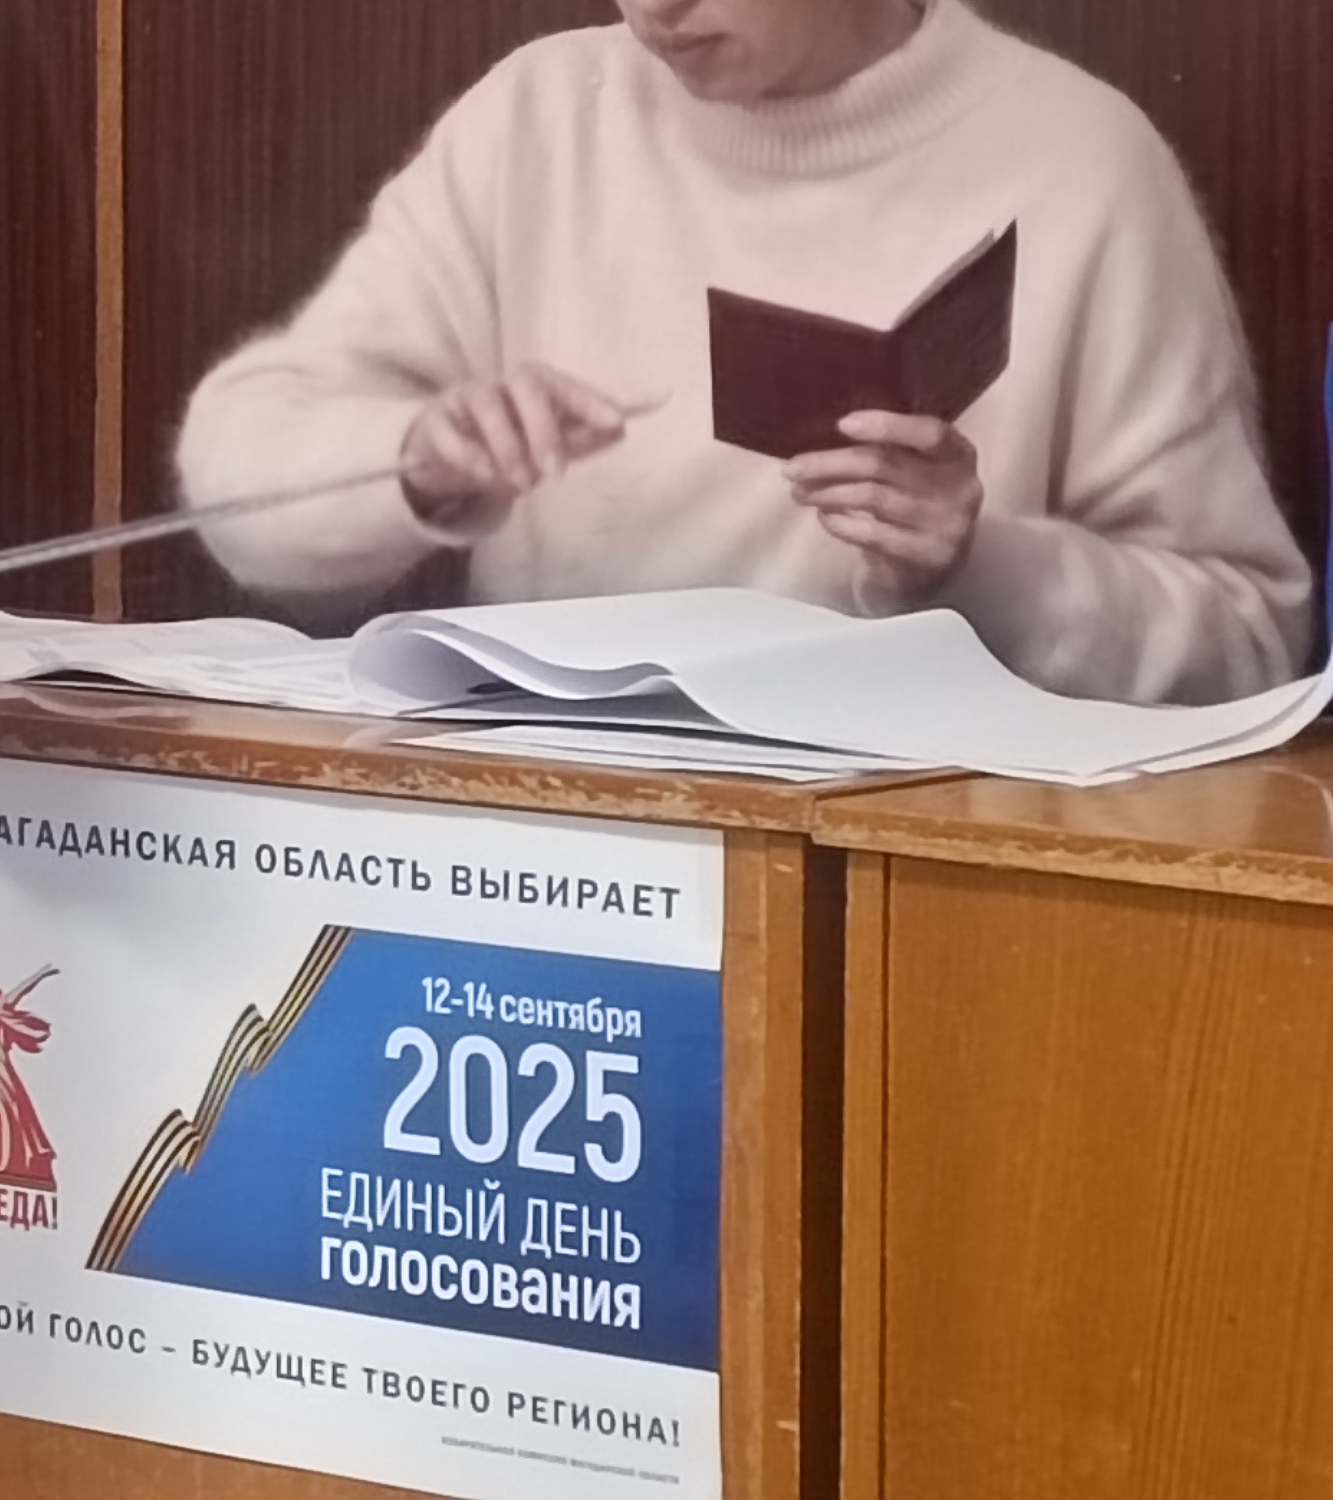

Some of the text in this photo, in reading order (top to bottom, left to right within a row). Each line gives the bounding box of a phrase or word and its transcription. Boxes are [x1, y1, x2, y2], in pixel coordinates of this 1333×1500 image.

[255, 845, 431, 891] ОБЛАСТЬ
[451, 866, 680, 920] ВЫБИРАЕТ
[422, 977, 642, 1041] 12-14 сентября
[383, 1026, 642, 1183] 2025
[321, 1168, 641, 1263] ЕДИНЫЙ ДЕНЬ
[320, 1238, 641, 1330] голосования
[50, 1313, 147, 1355] ГОЛОС
[192, 1338, 348, 1390] БУДУЩЕЕ
[362, 1367, 490, 1415] ТВОЕГО
[507, 1391, 680, 1448] РЕГИОНА!
